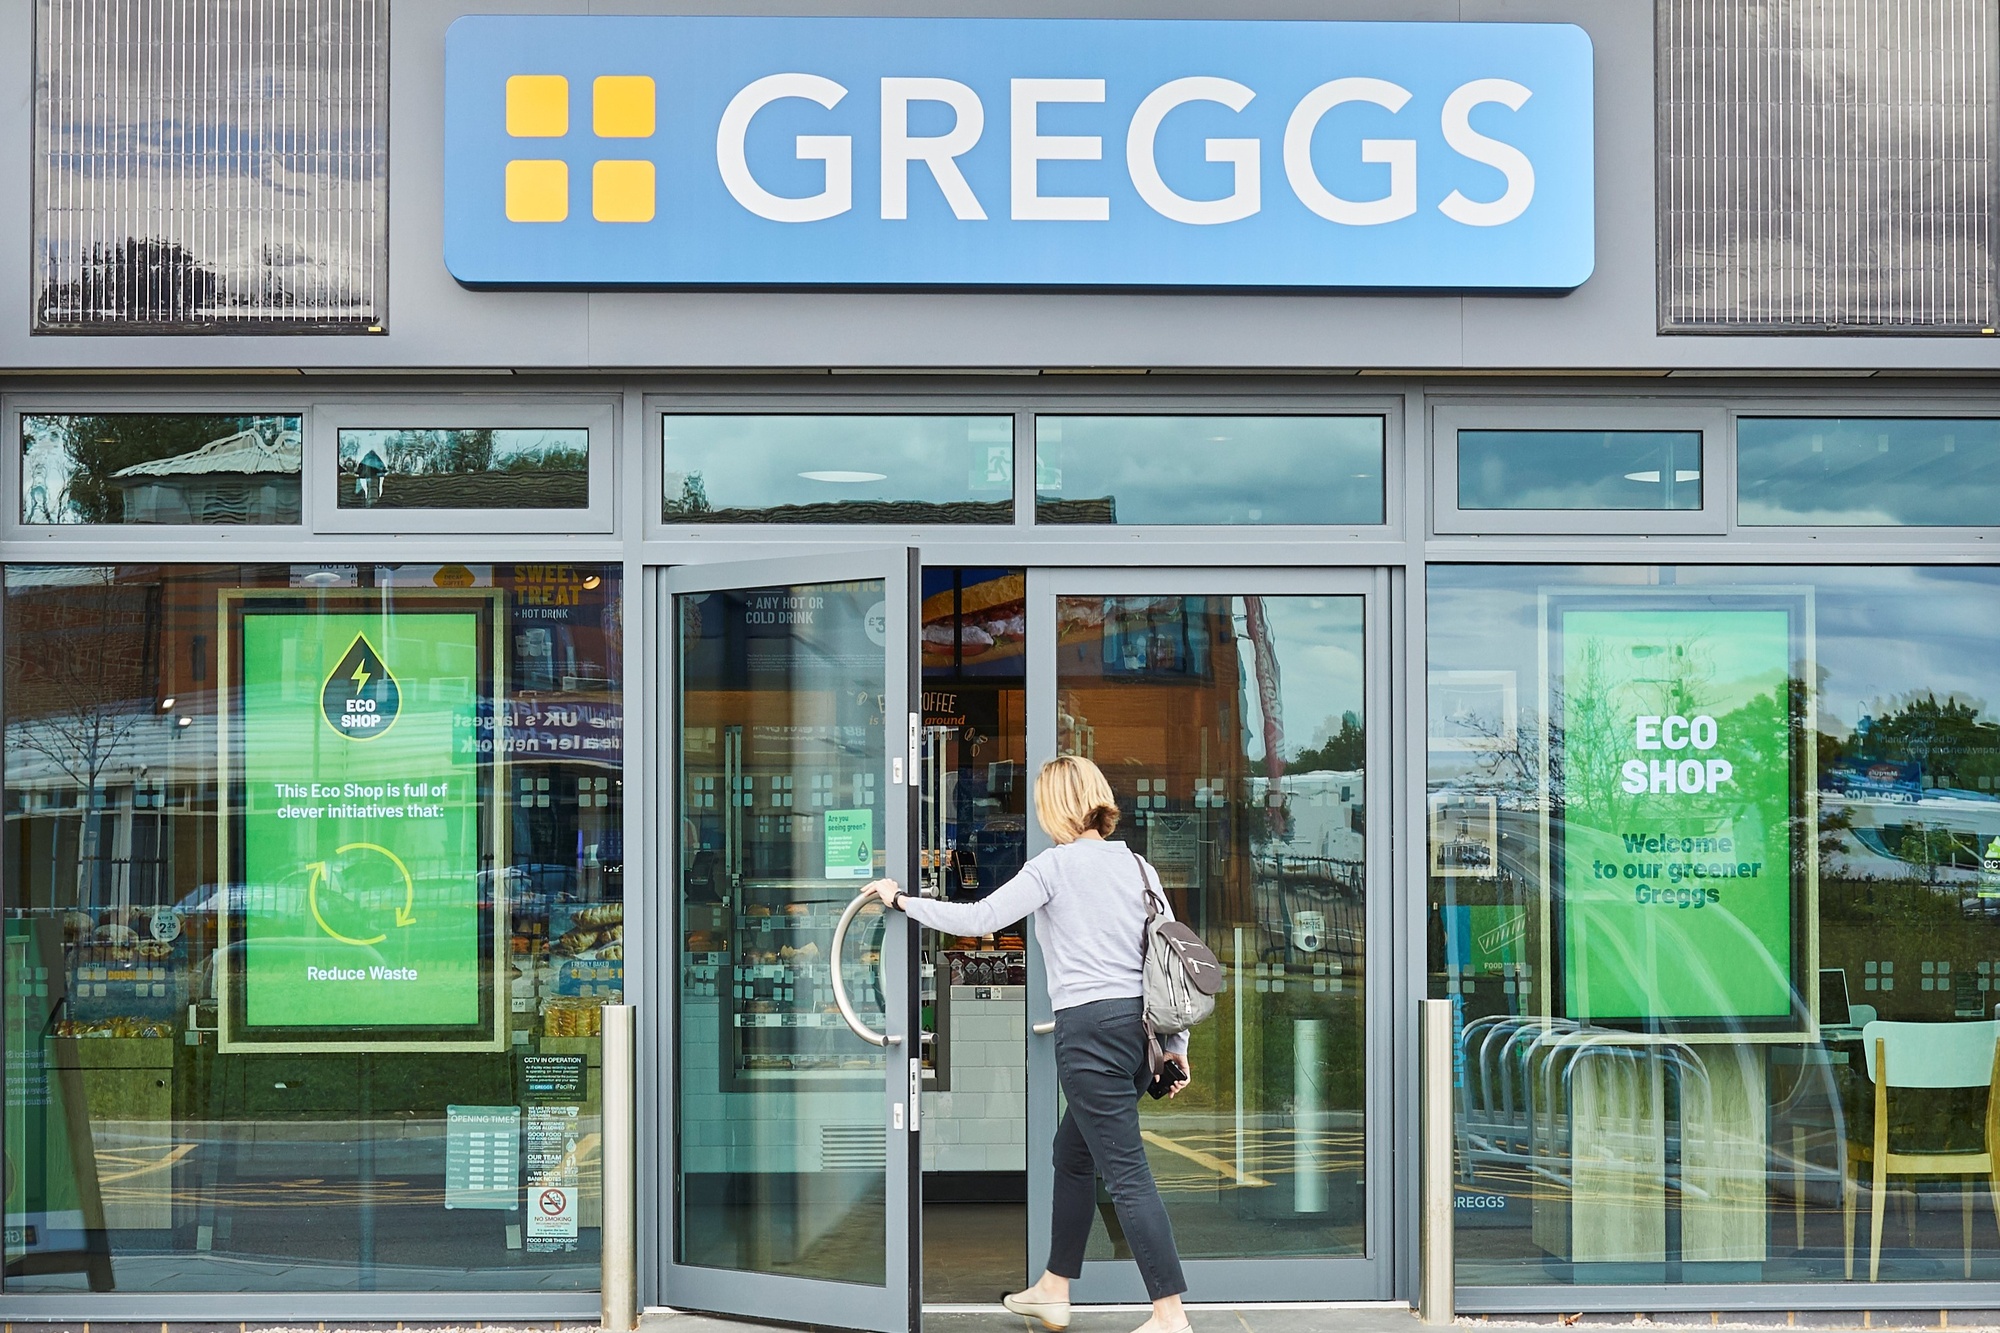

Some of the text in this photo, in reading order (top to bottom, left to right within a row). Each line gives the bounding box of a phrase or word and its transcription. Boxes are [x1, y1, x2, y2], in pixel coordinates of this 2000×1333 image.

[716, 72, 1536, 226] GREGGS
[514, 585, 582, 606] TREAT
[756, 597, 779, 609] ANY
[782, 597, 803, 609] HOT
[808, 596, 824, 609] OR
[522, 608, 539, 618] HOT
[541, 608, 568, 618] DRINK
[746, 612, 814, 624] COLD DRINK
[346, 699, 376, 713] ECO
[921, 692, 958, 714] OFFEE
[341, 714, 382, 728] SHOP
[869, 715, 966, 726] is ground
[1636, 715, 1718, 750] ECO
[1621, 759, 1733, 794] SHOP
[274, 783, 447, 800] This Eco Shop is full of
[277, 804, 444, 818] clever initiatives that:
[1622, 833, 1732, 853] Welcome
[1593, 860, 1762, 883] to our greener
[1635, 884, 1720, 909] Greggs
[308, 966, 417, 980] Reduce Waste
[451, 1114, 515, 1124] OPENING TIMES
